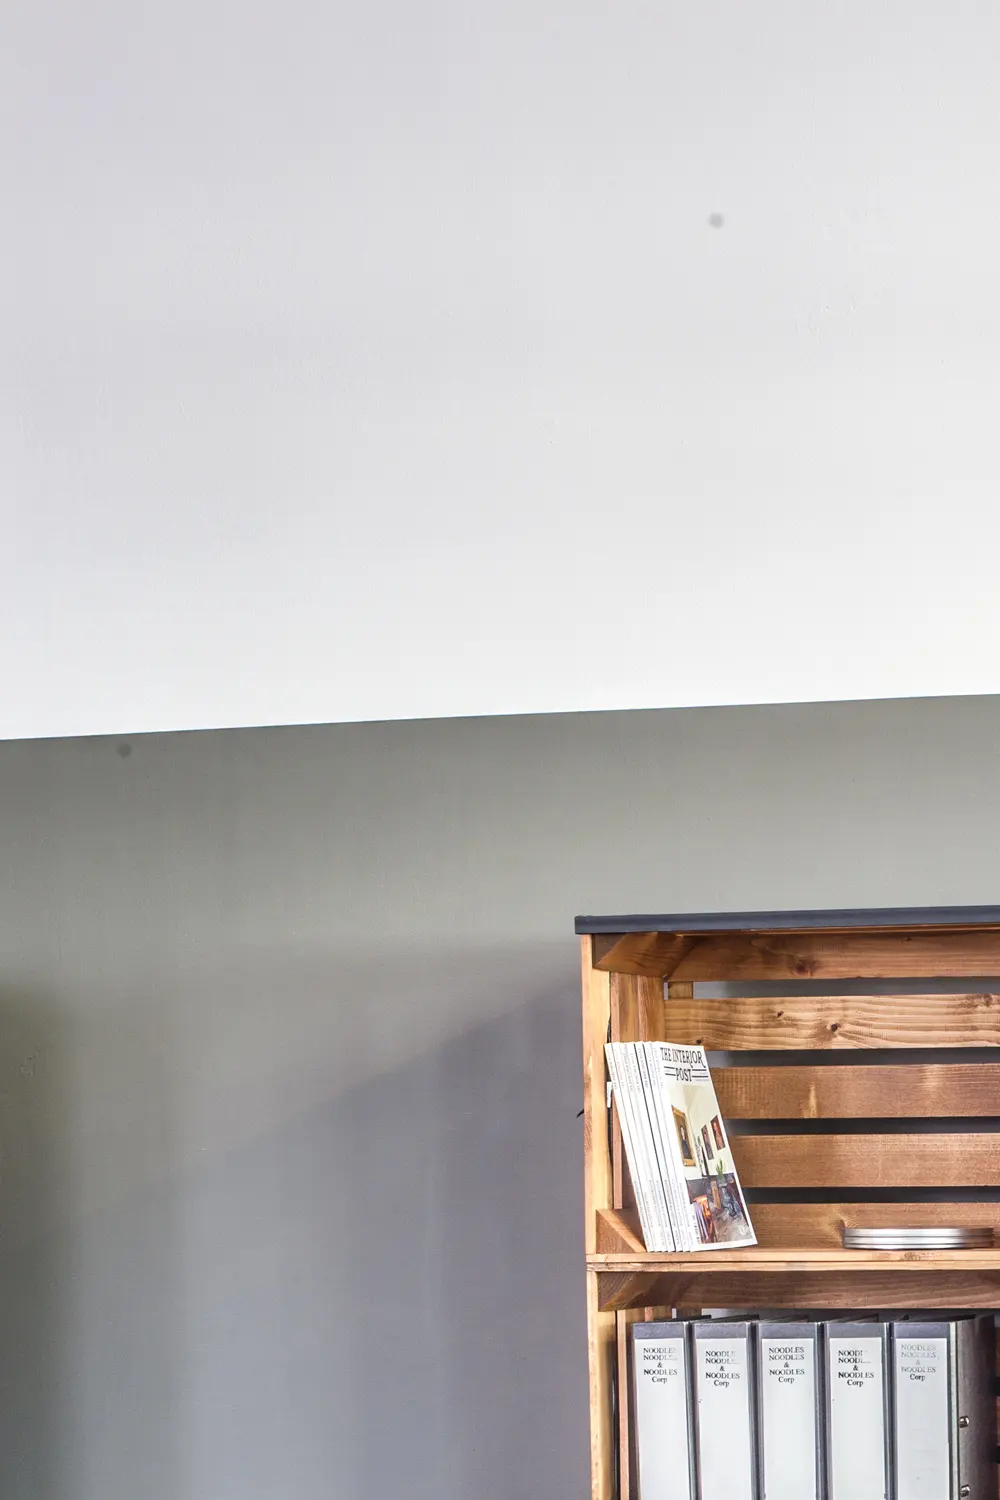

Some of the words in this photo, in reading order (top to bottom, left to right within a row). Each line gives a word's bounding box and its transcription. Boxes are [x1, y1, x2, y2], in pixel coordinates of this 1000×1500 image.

[660, 1047, 672, 1061] THE
[672, 1049, 706, 1068] INTERIOR
[675, 1067, 692, 1082] POST
[705, 1357, 740, 1365] NOODL
[652, 1376, 668, 1384] Corp
[909, 1374, 926, 1382] Corp
[713, 1380, 730, 1388] Corp
[847, 1379, 864, 1387] Corp
